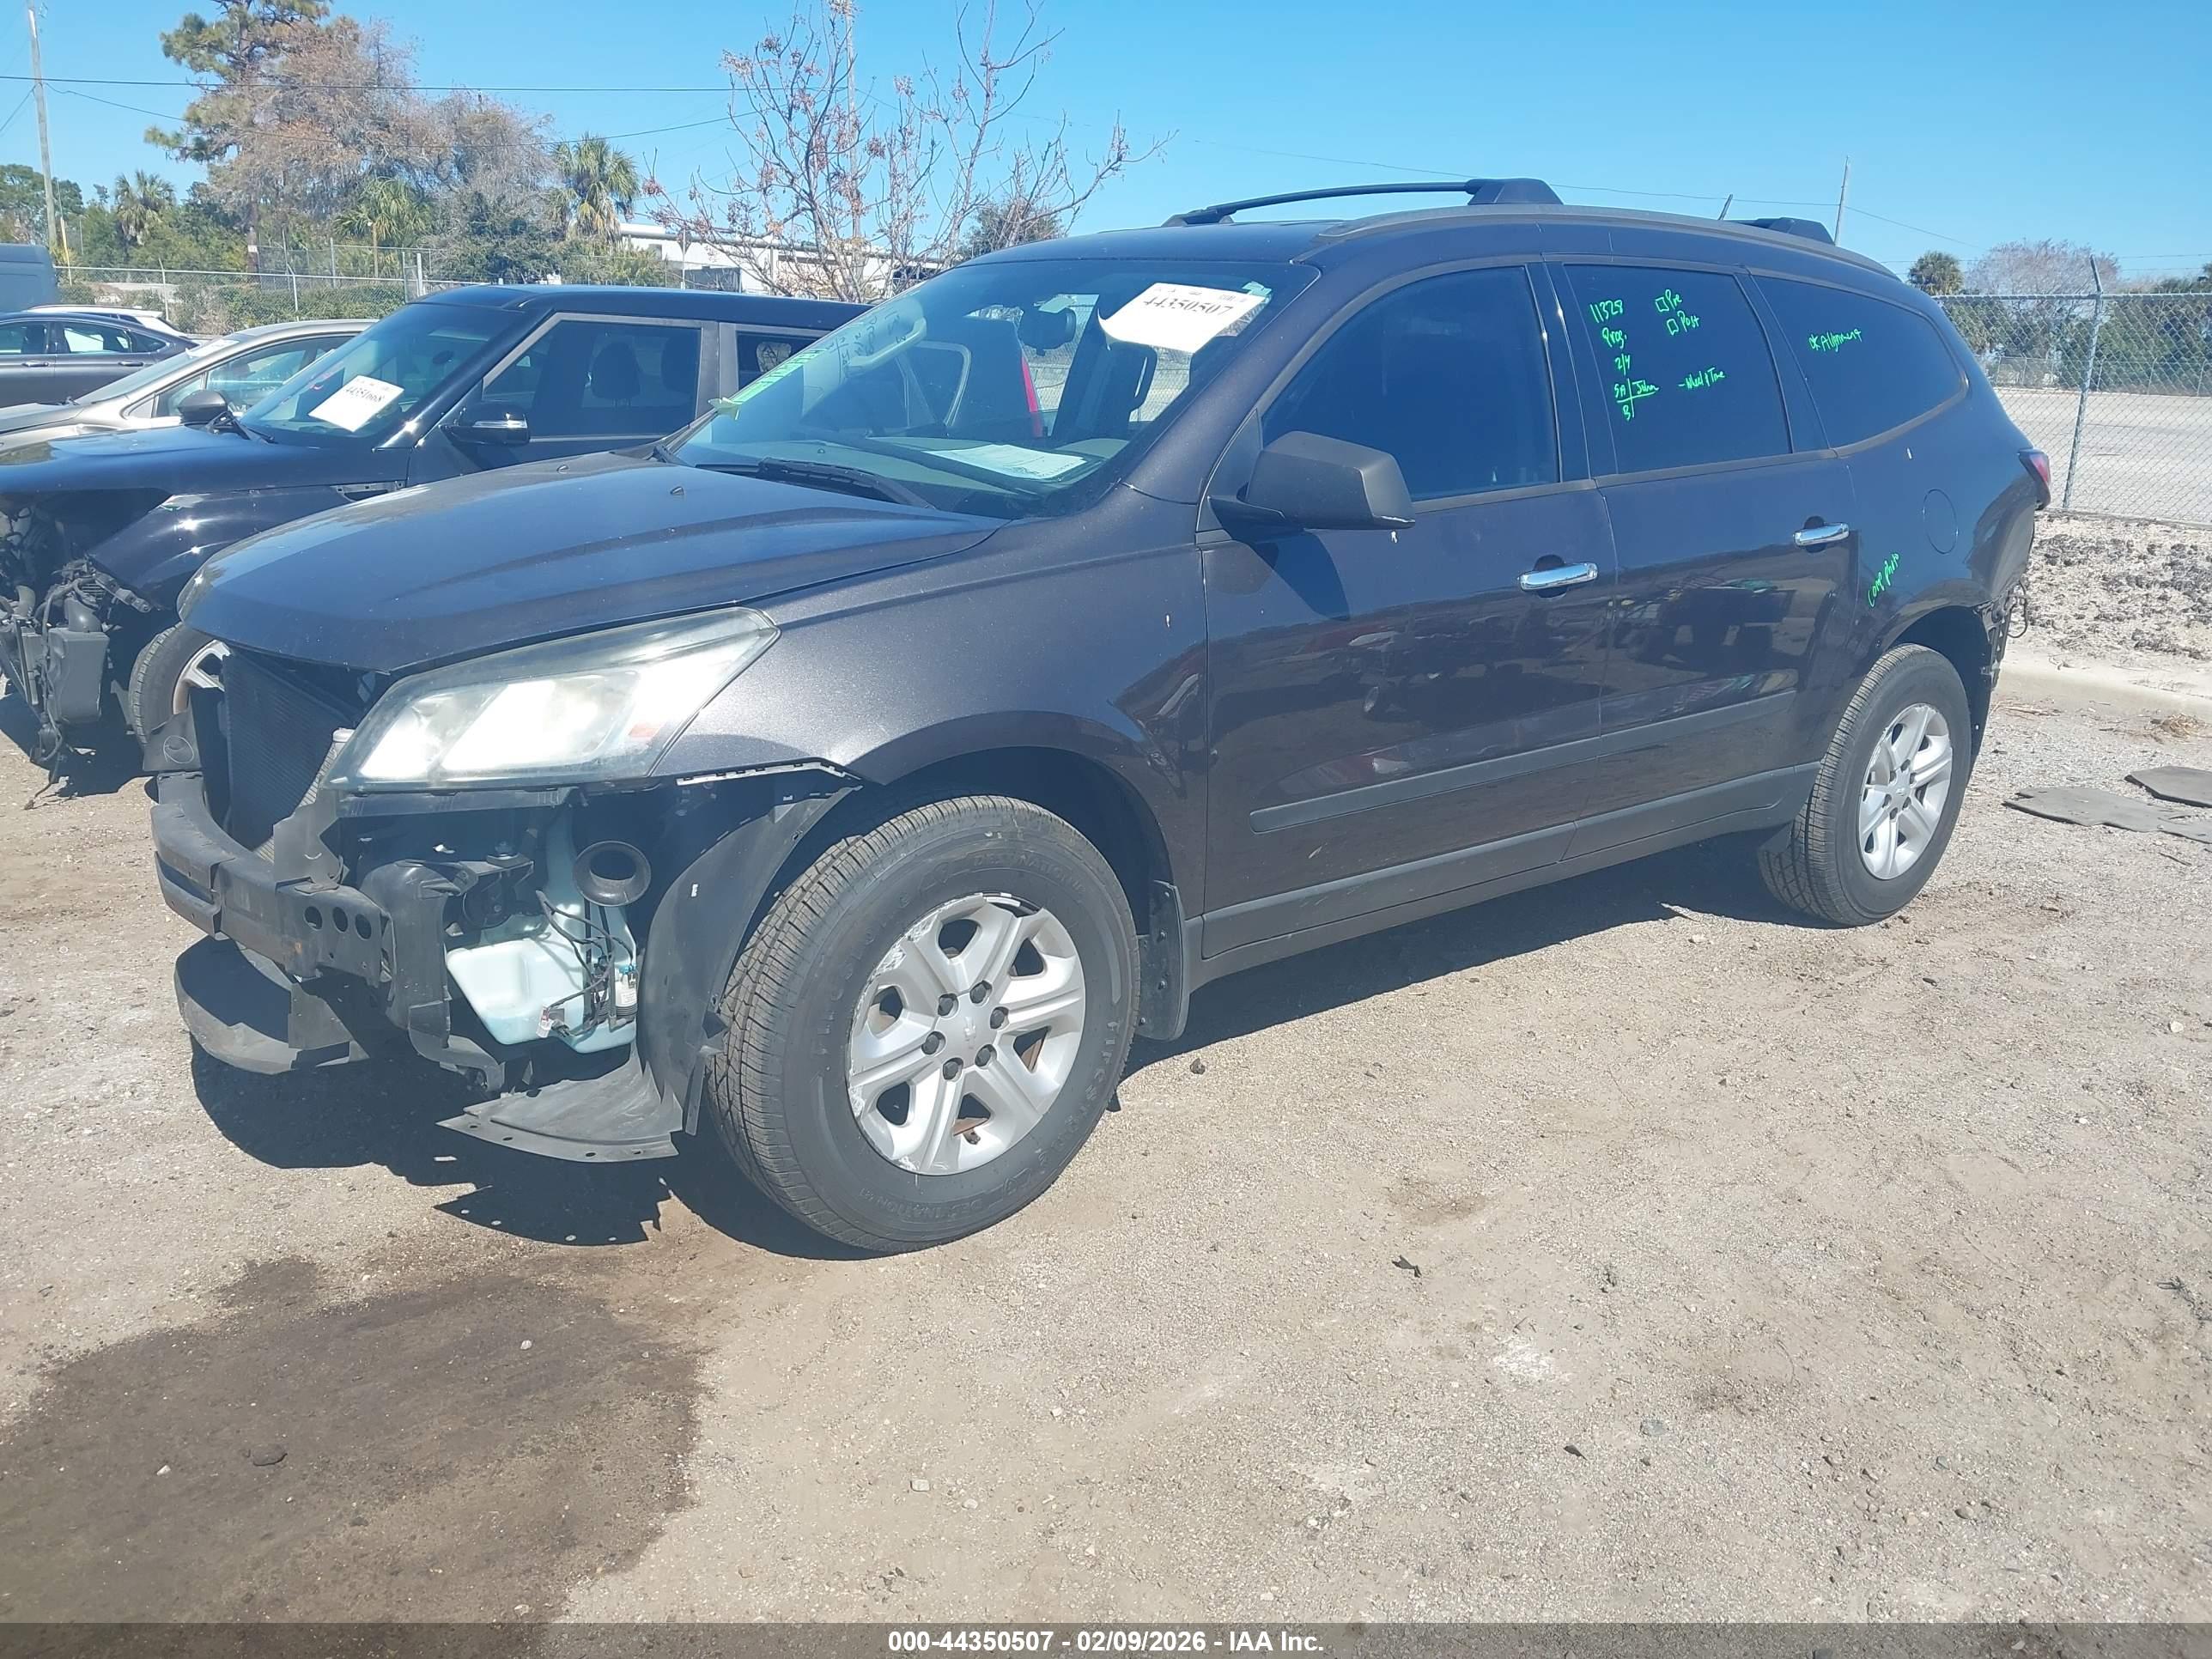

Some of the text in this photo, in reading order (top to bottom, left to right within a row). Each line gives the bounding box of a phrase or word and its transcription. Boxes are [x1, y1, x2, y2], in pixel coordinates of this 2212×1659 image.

[1143, 295, 1233, 316] 44350507
[1665, 289, 1682, 310] Pre
[1677, 311, 1699, 332] Post
[1614, 353, 1631, 375] 2/4
